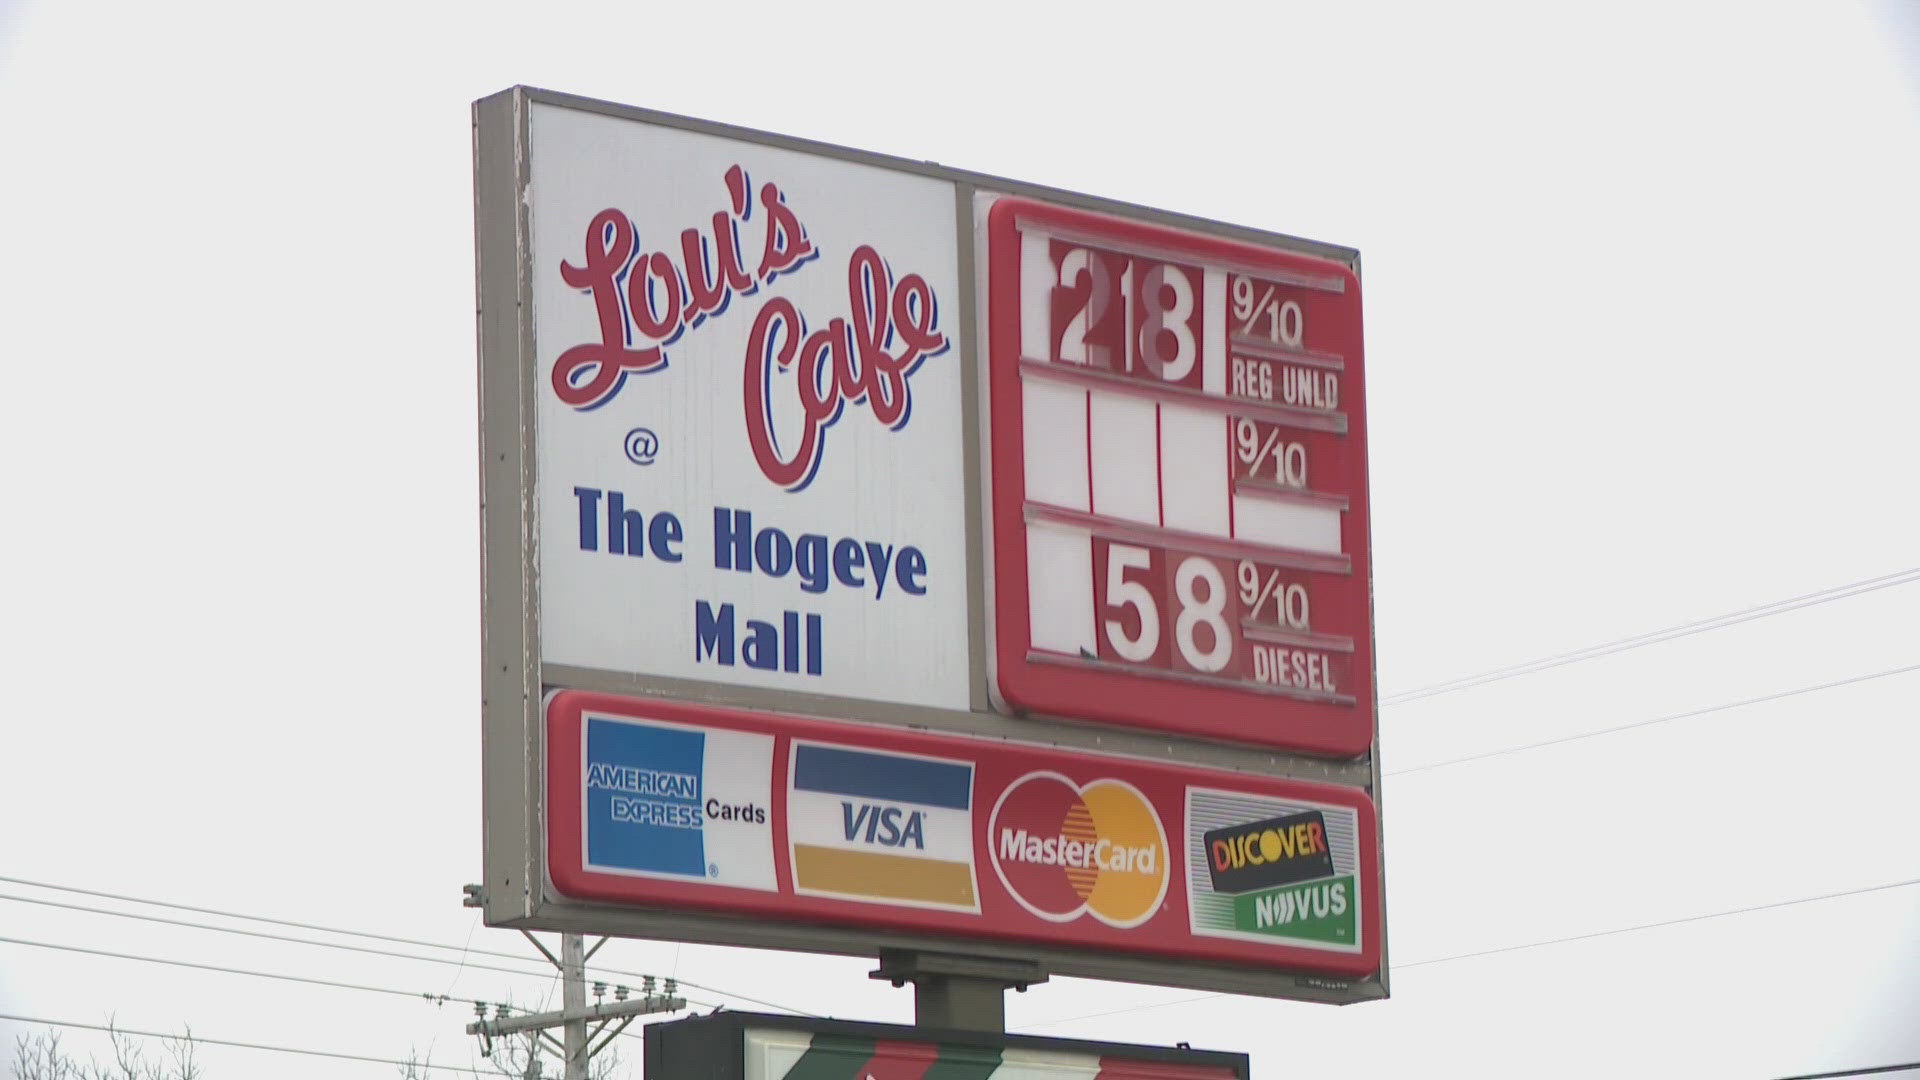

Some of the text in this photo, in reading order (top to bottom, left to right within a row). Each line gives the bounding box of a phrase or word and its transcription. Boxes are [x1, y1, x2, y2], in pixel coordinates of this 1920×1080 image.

[552, 164, 818, 411] Lou's
[743, 245, 950, 493] Cafe
[1232, 358, 1339, 410] REG UNLD
[624, 428, 659, 465] @
[574, 486, 927, 600] The Hogeye
[1105, 543, 1233, 673] 58
[695, 599, 822, 676] Mall
[1253, 645, 1336, 693] DIESEL
[587, 763, 697, 799] AMERICAN
[611, 795, 704, 829] EXPRESS
[705, 798, 766, 825] Cards
[842, 802, 924, 849] VISA
[1000, 827, 1156, 875] MasterCard
[1212, 821, 1325, 873] DISCOVER
